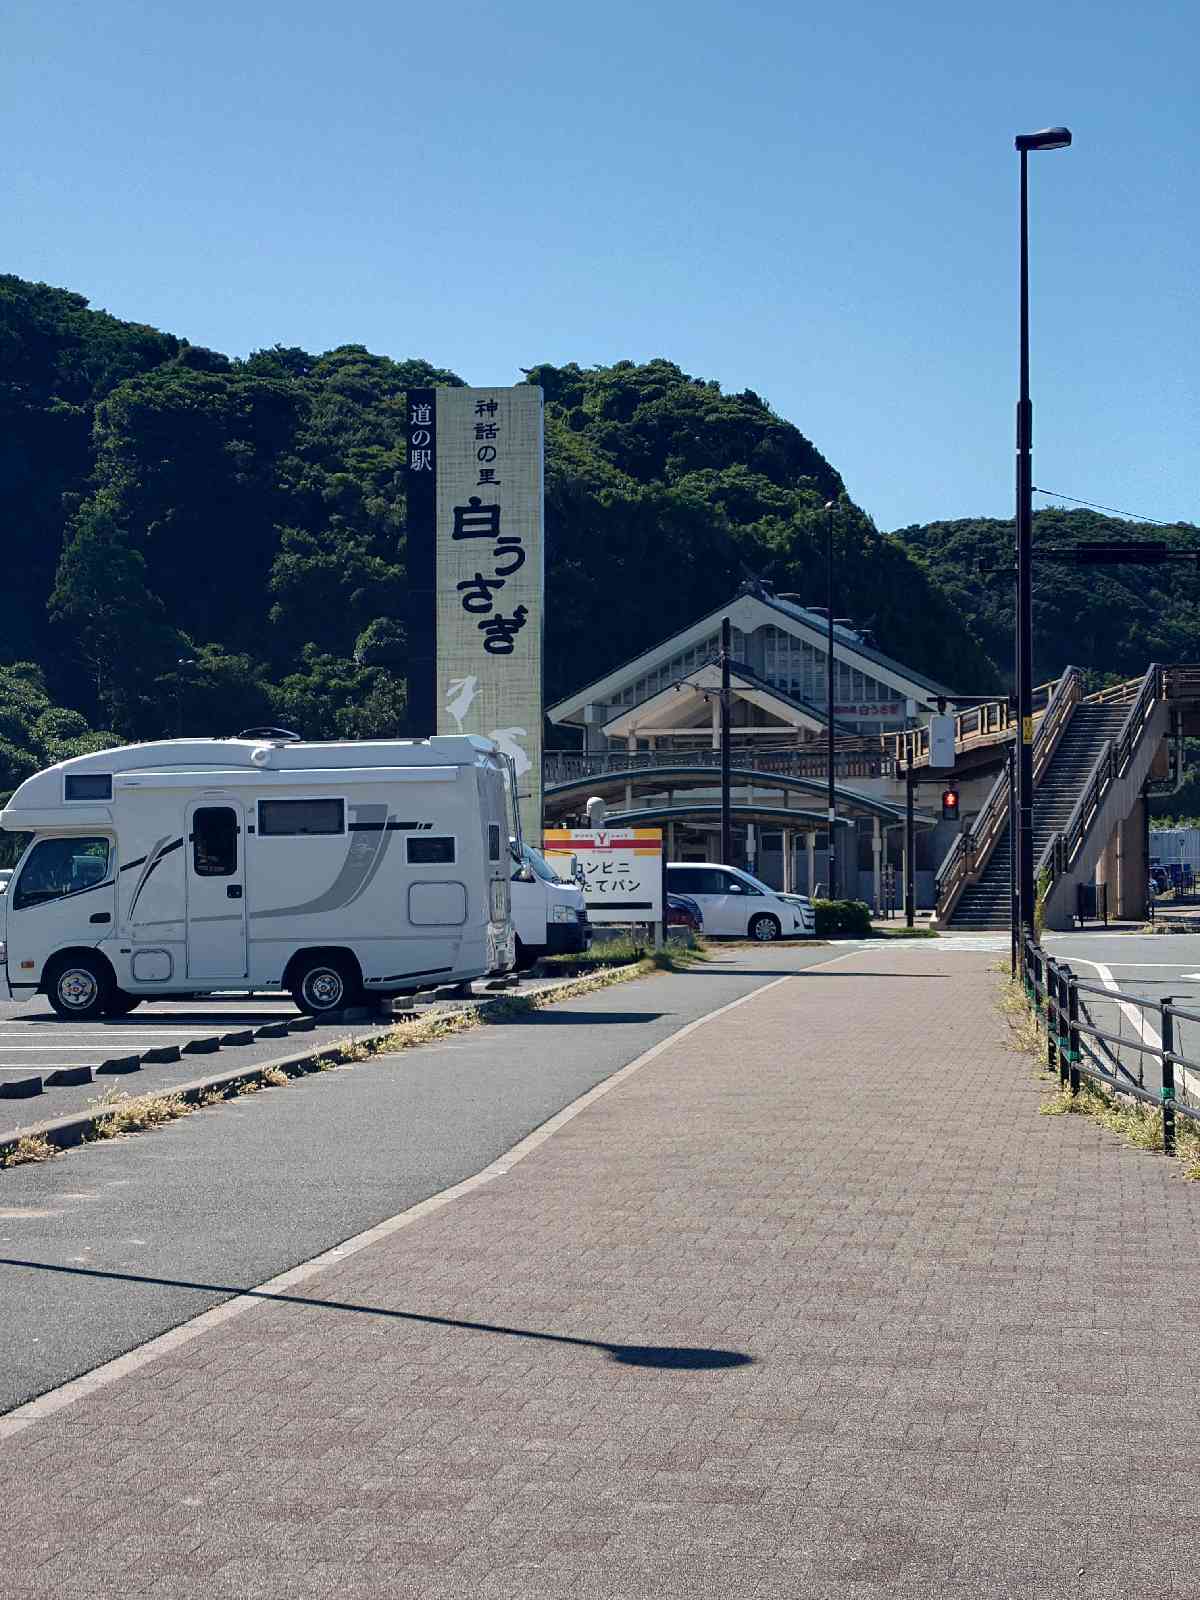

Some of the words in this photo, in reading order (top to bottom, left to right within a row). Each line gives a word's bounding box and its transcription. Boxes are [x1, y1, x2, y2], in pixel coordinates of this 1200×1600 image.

[410, 403, 432, 471] 道の駅
[473, 399, 501, 486] 神話の里
[452, 496, 528, 655] 白うさぎ
[579, 879, 641, 893] たてパン
